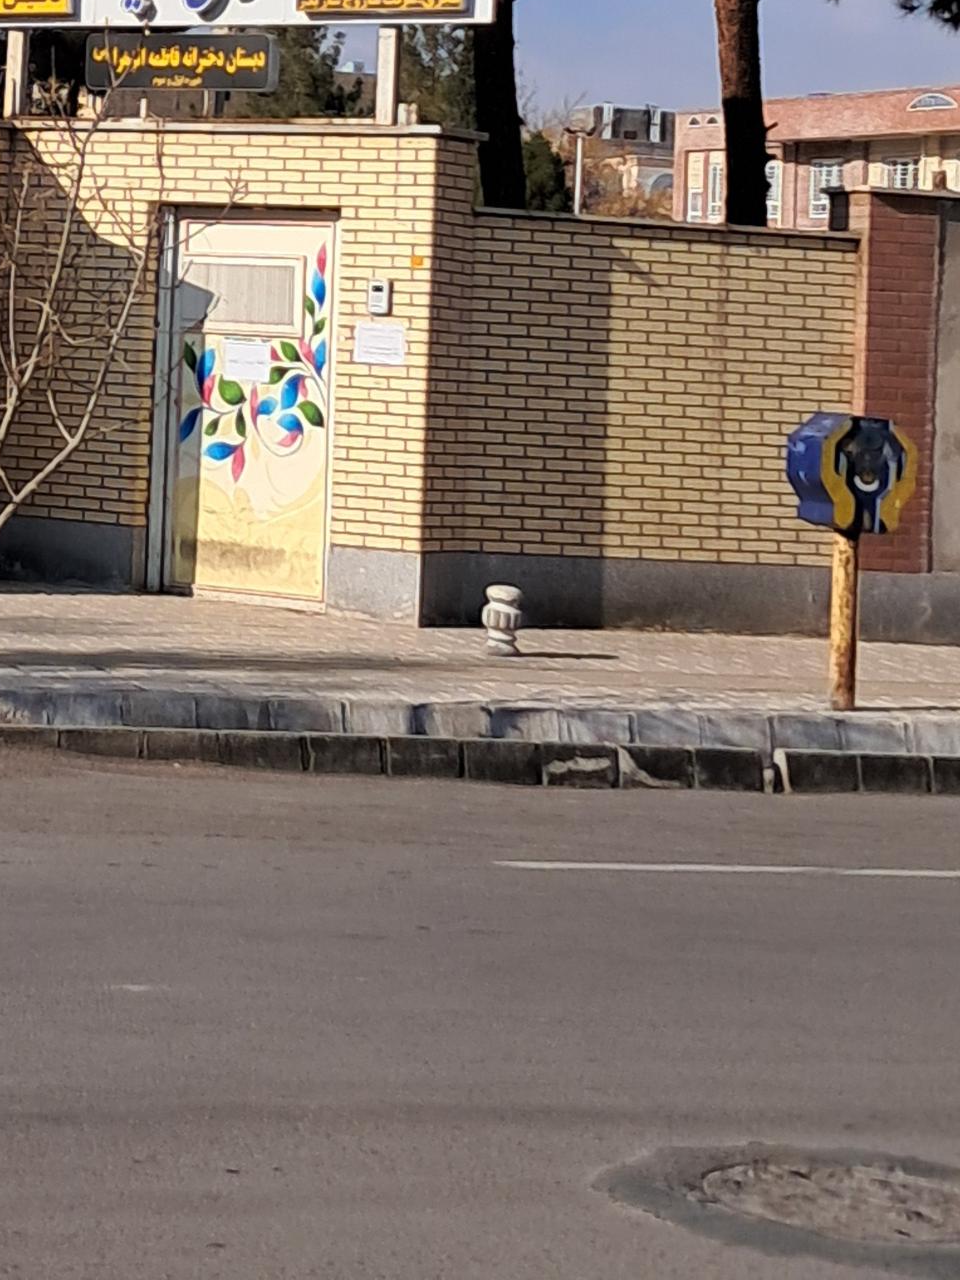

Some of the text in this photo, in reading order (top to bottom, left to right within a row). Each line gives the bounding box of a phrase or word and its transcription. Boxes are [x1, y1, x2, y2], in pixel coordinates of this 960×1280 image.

[148, 45, 180, 68] فاطمه
[183, 47, 225, 74] دخترانه
[226, 47, 266, 74] دبستان
